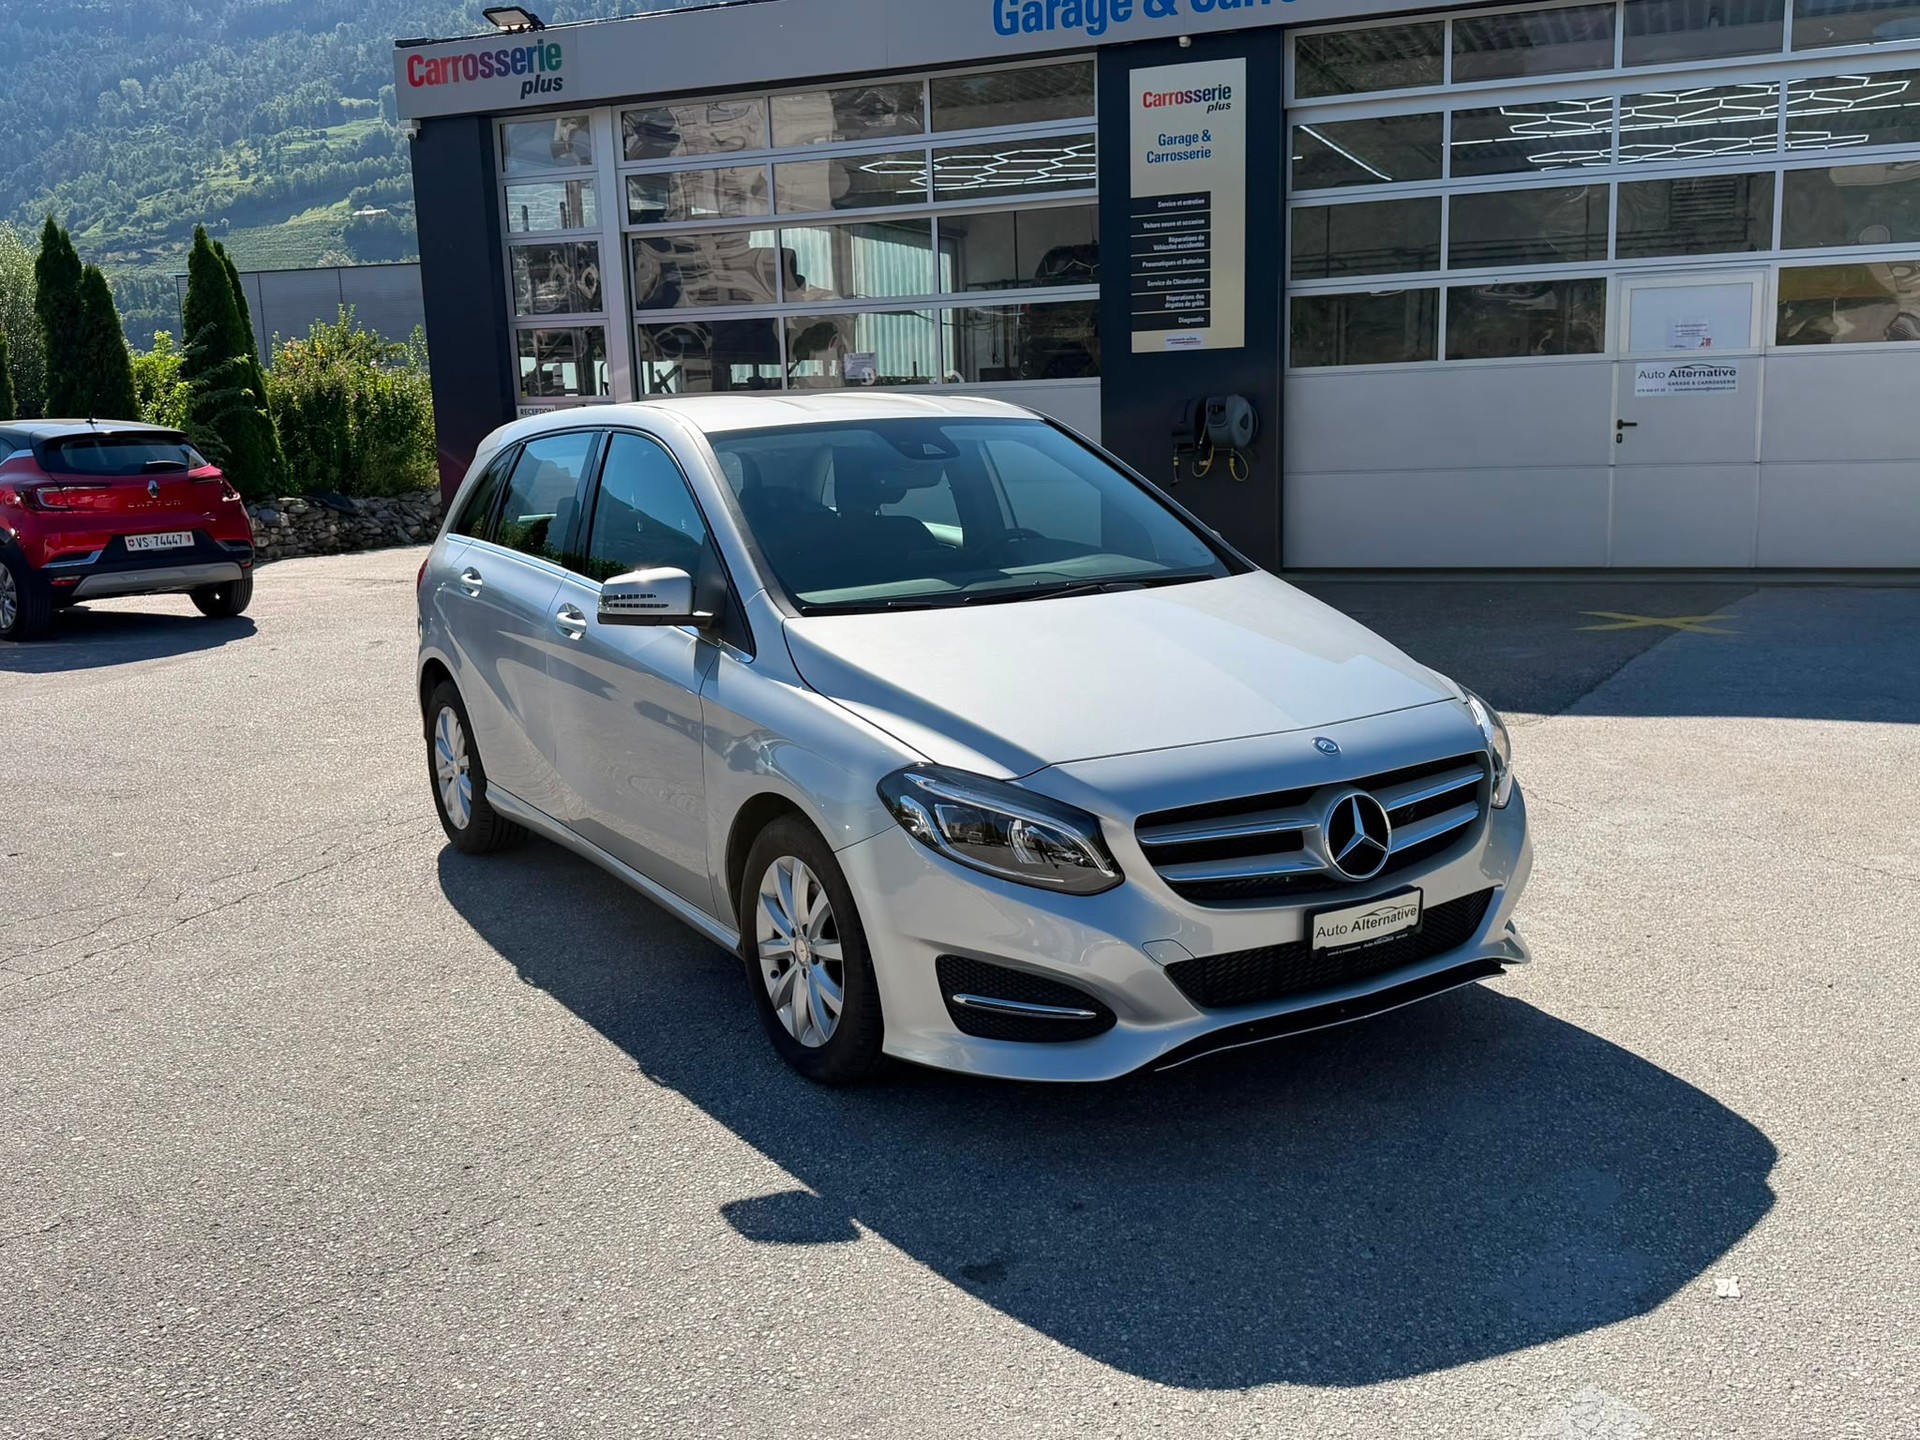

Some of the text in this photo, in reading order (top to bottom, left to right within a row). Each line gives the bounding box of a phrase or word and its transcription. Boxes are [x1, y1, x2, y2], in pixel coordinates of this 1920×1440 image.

[992, 0, 1133, 36] Garage
[406, 39, 563, 88] Carrosserie
[520, 74, 564, 99] plus
[1142, 84, 1232, 109] Carrosserie
[1206, 101, 1232, 114] plus
[1158, 129, 1212, 147] Garage &
[1146, 146, 1212, 164] Carrosserie
[1638, 368, 1737, 379] Auto Alternative
[1315, 906, 1418, 939] Auto Alternative
